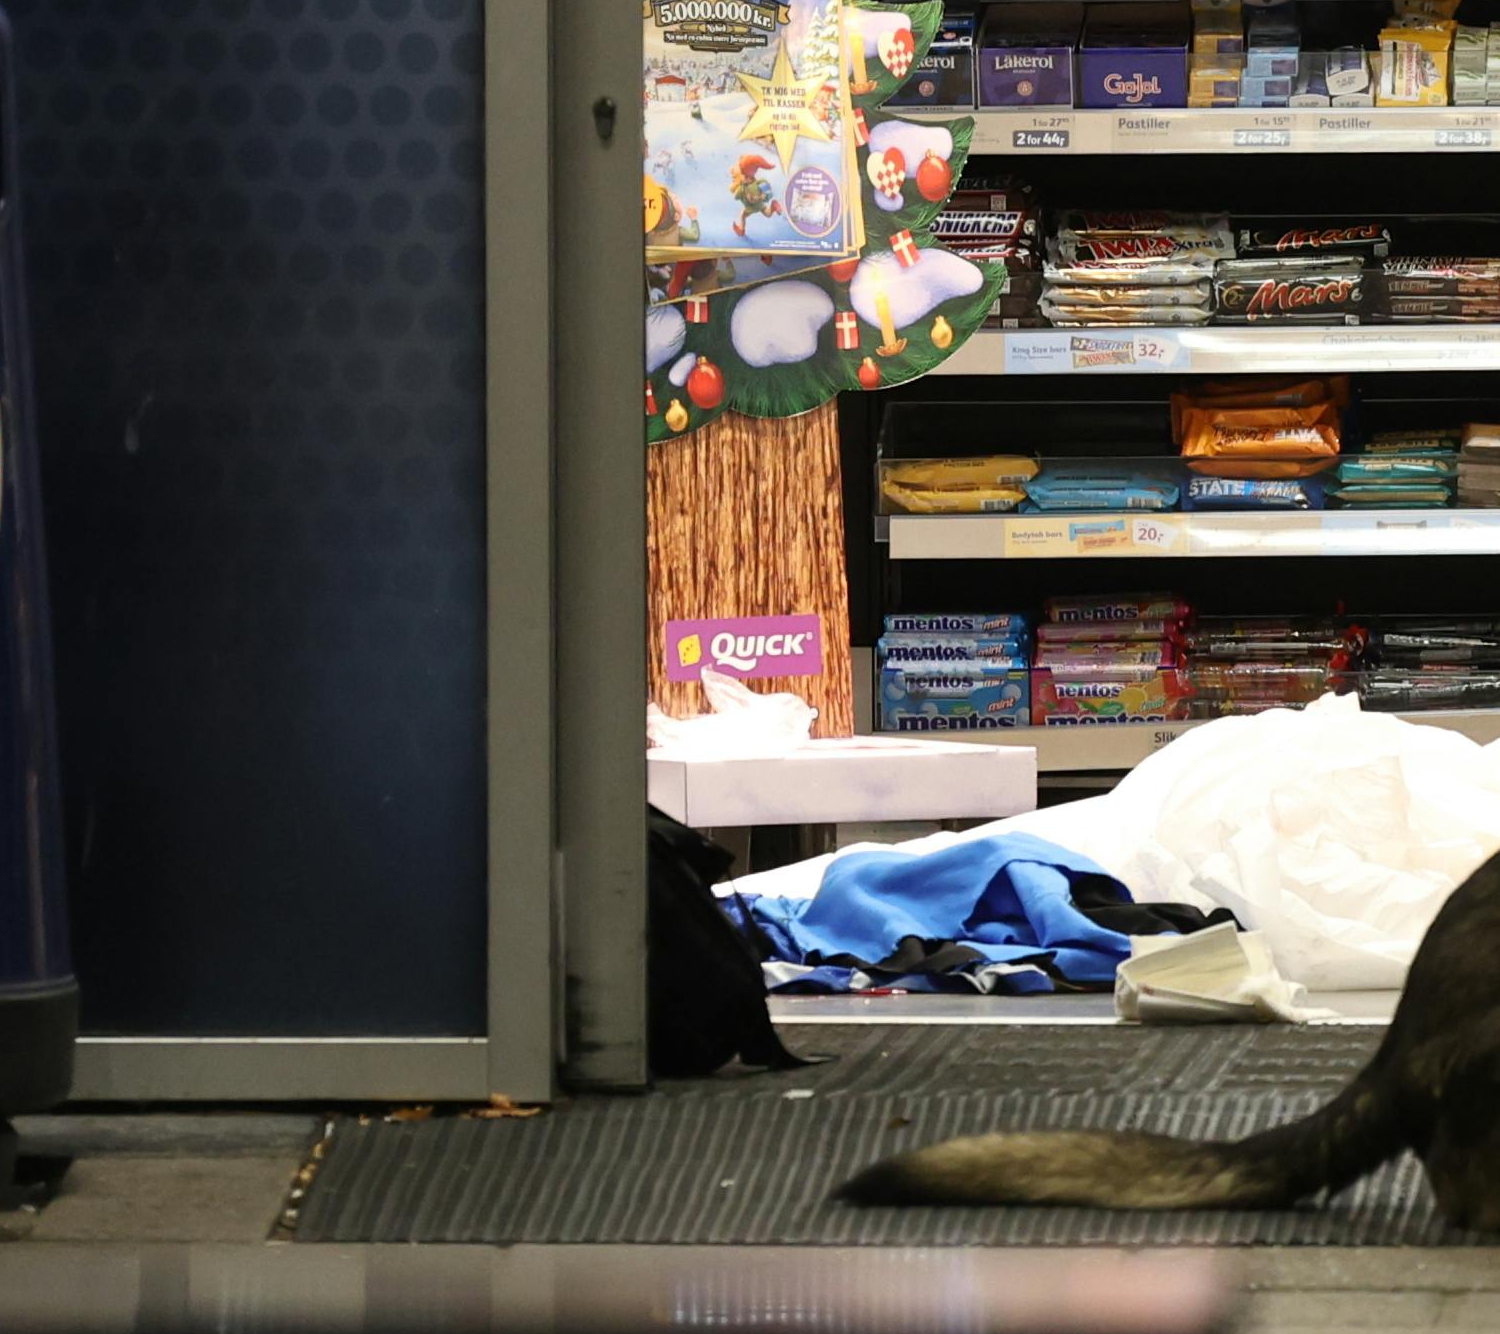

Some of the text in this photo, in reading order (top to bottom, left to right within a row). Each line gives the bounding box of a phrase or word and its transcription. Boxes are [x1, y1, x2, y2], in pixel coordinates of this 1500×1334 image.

[659, 0, 772, 28] 5.000.000 kr.
[994, 54, 1054, 70] Läkerol
[774, 86, 788, 97] MIG
[1117, 117, 1171, 130] Pastiller
[1318, 117, 1372, 130] Pastiller
[1016, 132, 1024, 145] 2
[1026, 132, 1042, 145] for
[1238, 132, 1246, 144] 2
[1439, 132, 1447, 144] 2
[1276, 224, 1382, 252] Mars
[1246, 278, 1353, 321] Mars
[1057, 605, 1140, 622] mentos
[892, 616, 974, 631] mentos
[710, 632, 807, 673] QUICK
[886, 643, 969, 662] mentos
[987, 696, 1017, 713] mint
[896, 714, 1018, 731] mentos
